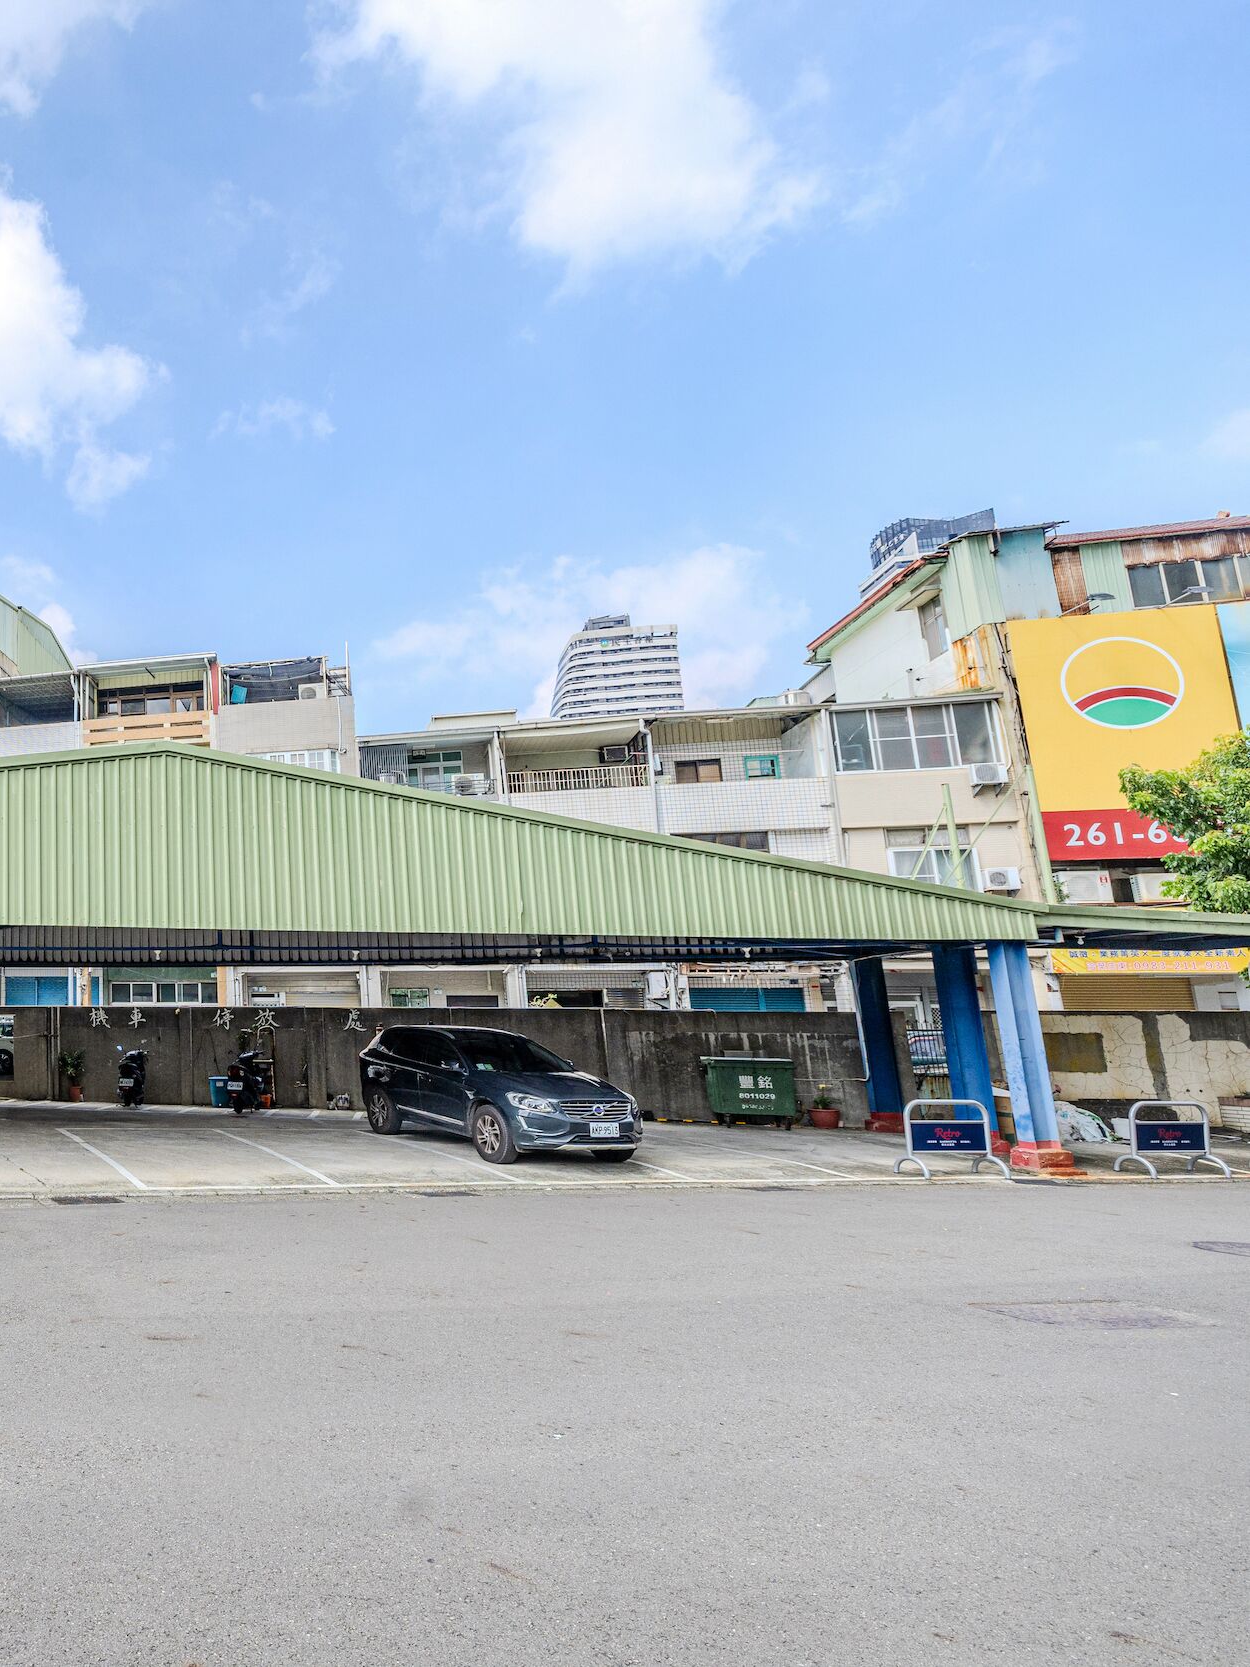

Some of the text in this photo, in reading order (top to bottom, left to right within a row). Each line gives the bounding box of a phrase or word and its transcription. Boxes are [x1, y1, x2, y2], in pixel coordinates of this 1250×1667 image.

[1063, 820, 1189, 847] 261-6
[739, 1075, 774, 1089] 豐銘
[739, 1092, 776, 1100] 8011029
[934, 1127, 962, 1140] Retro
[1157, 1128, 1183, 1140] Retro
